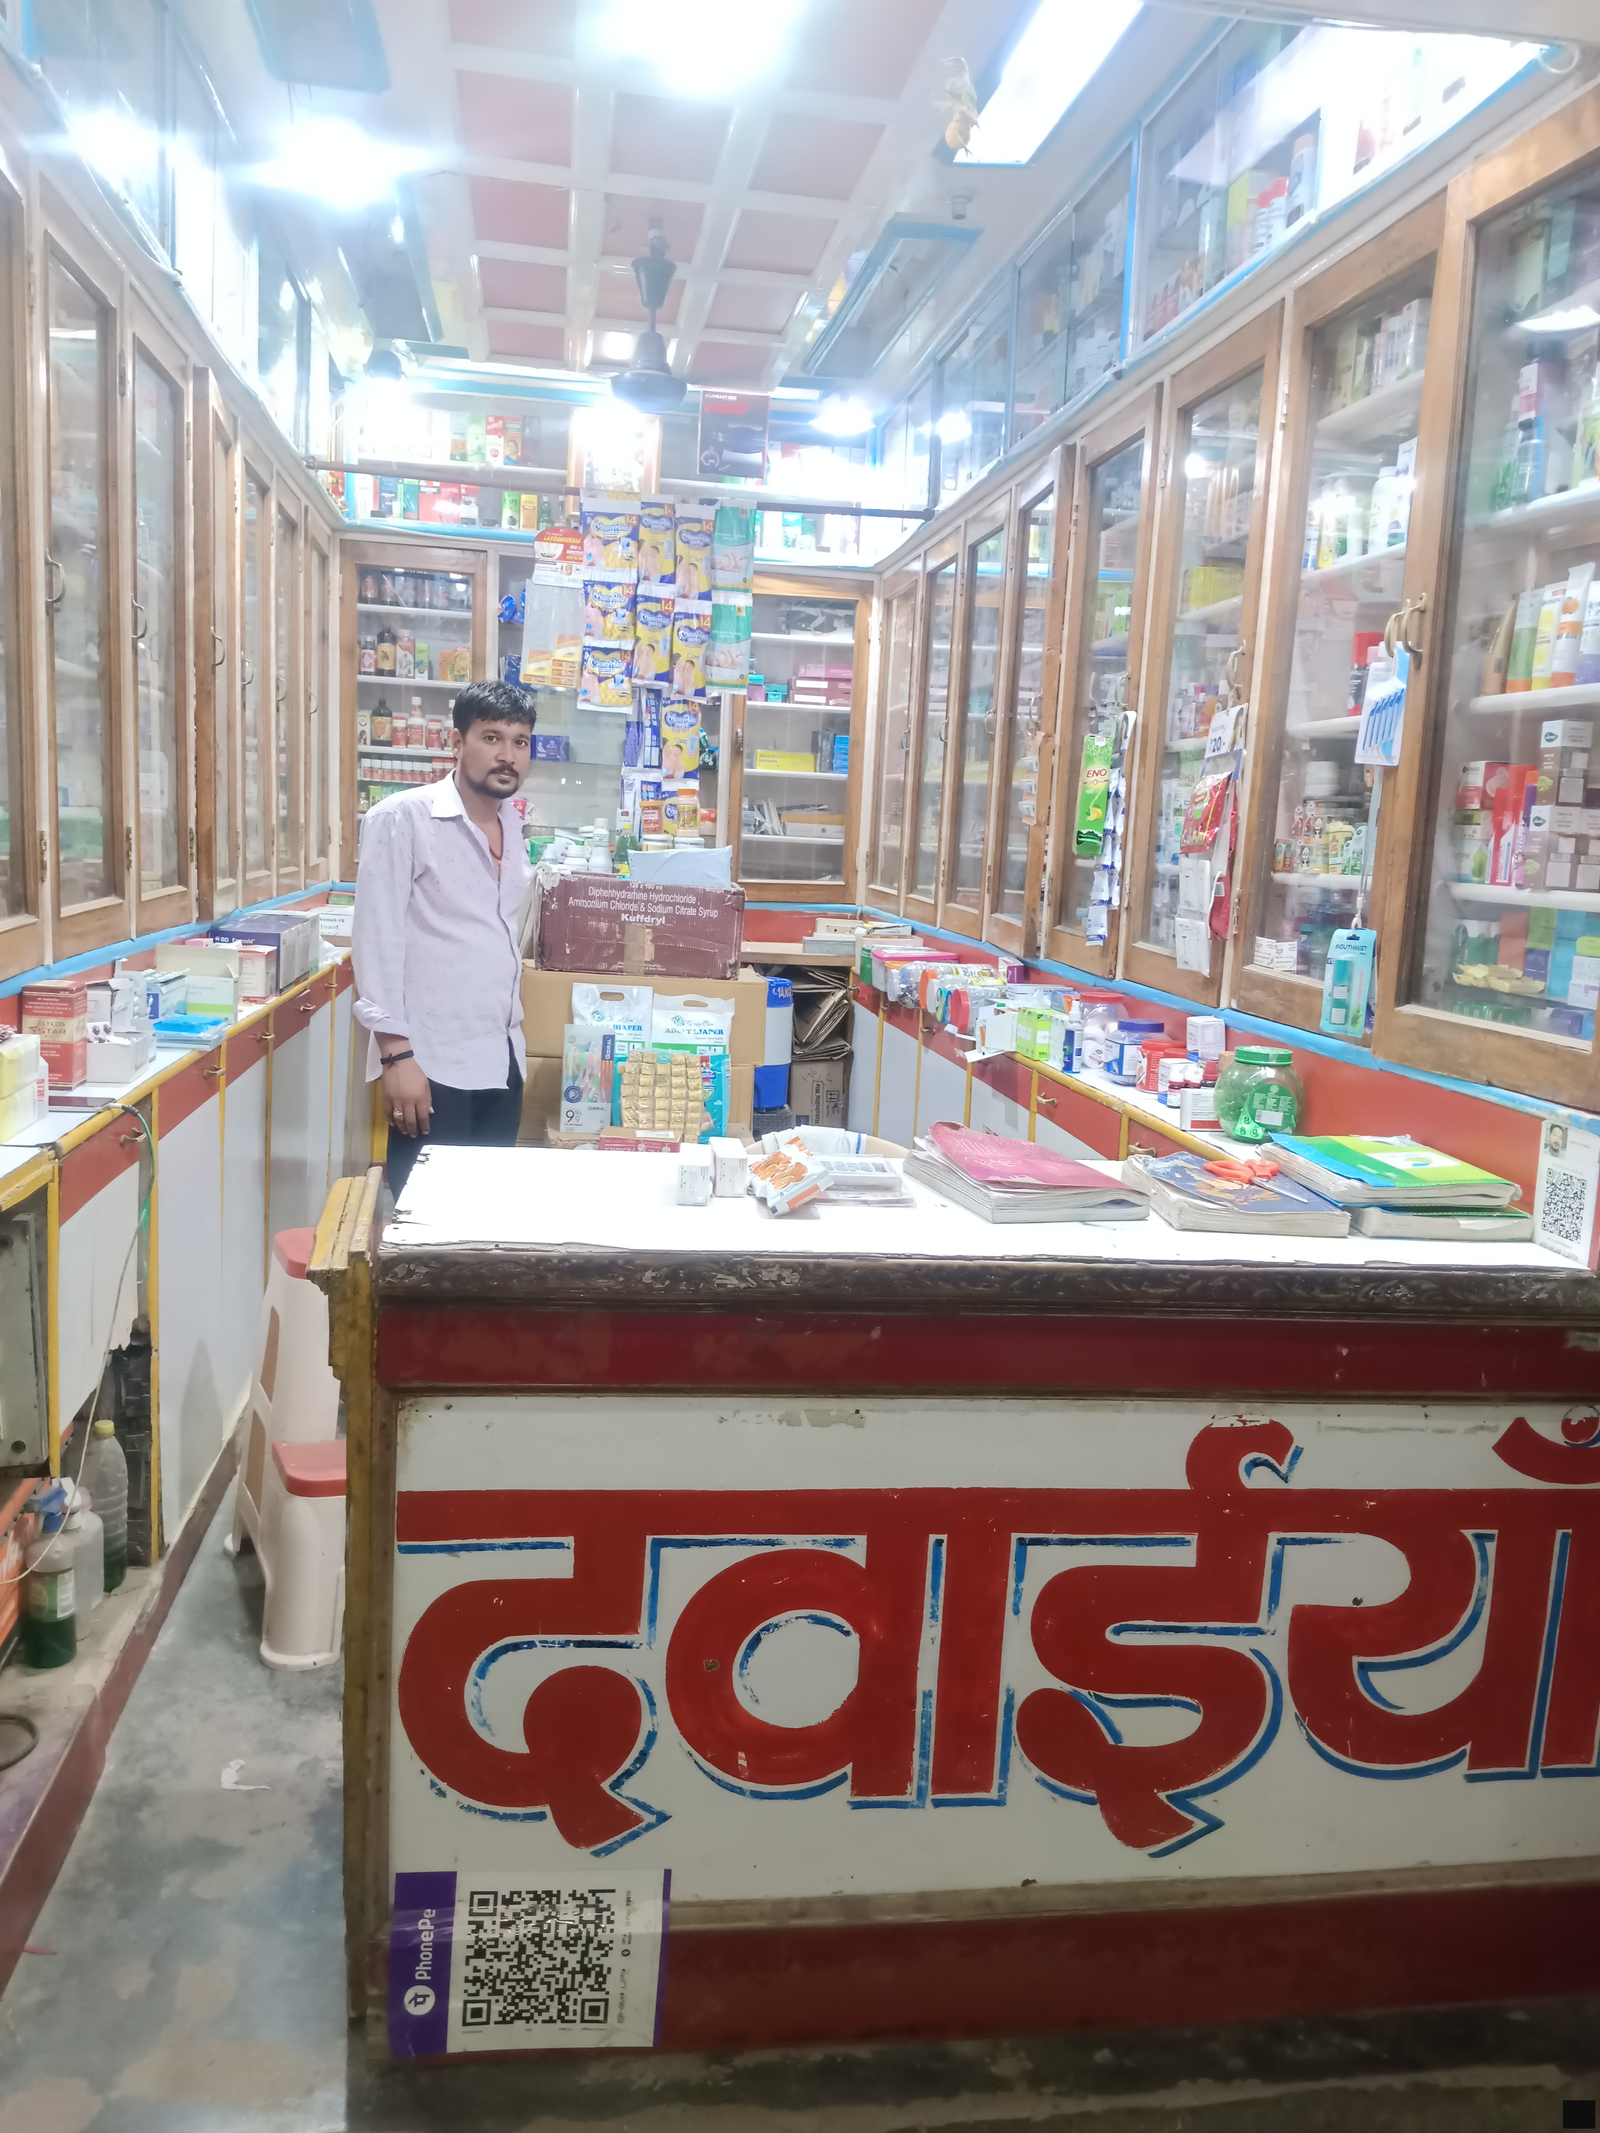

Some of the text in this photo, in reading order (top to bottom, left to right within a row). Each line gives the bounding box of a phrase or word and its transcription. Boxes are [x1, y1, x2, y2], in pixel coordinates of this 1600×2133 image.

[626, 515, 637, 525] 14
[703, 521, 714, 531] 14
[623, 587, 633, 596] 14
[661, 600, 673, 611] 14
[701, 616, 711, 627] 14
[688, 702, 700, 711] 14
[1086, 768, 1108, 778] ENO
[568, 896, 719, 919] Ammonium Chloride & Sodium Citrate Syrup
[621, 913, 666, 924] Kuffdryl
[1335, 943, 1369, 952] MOUTHMIST
[38, 1027, 67, 1035] STAR
[415, 1908, 436, 1981] PhonePe
